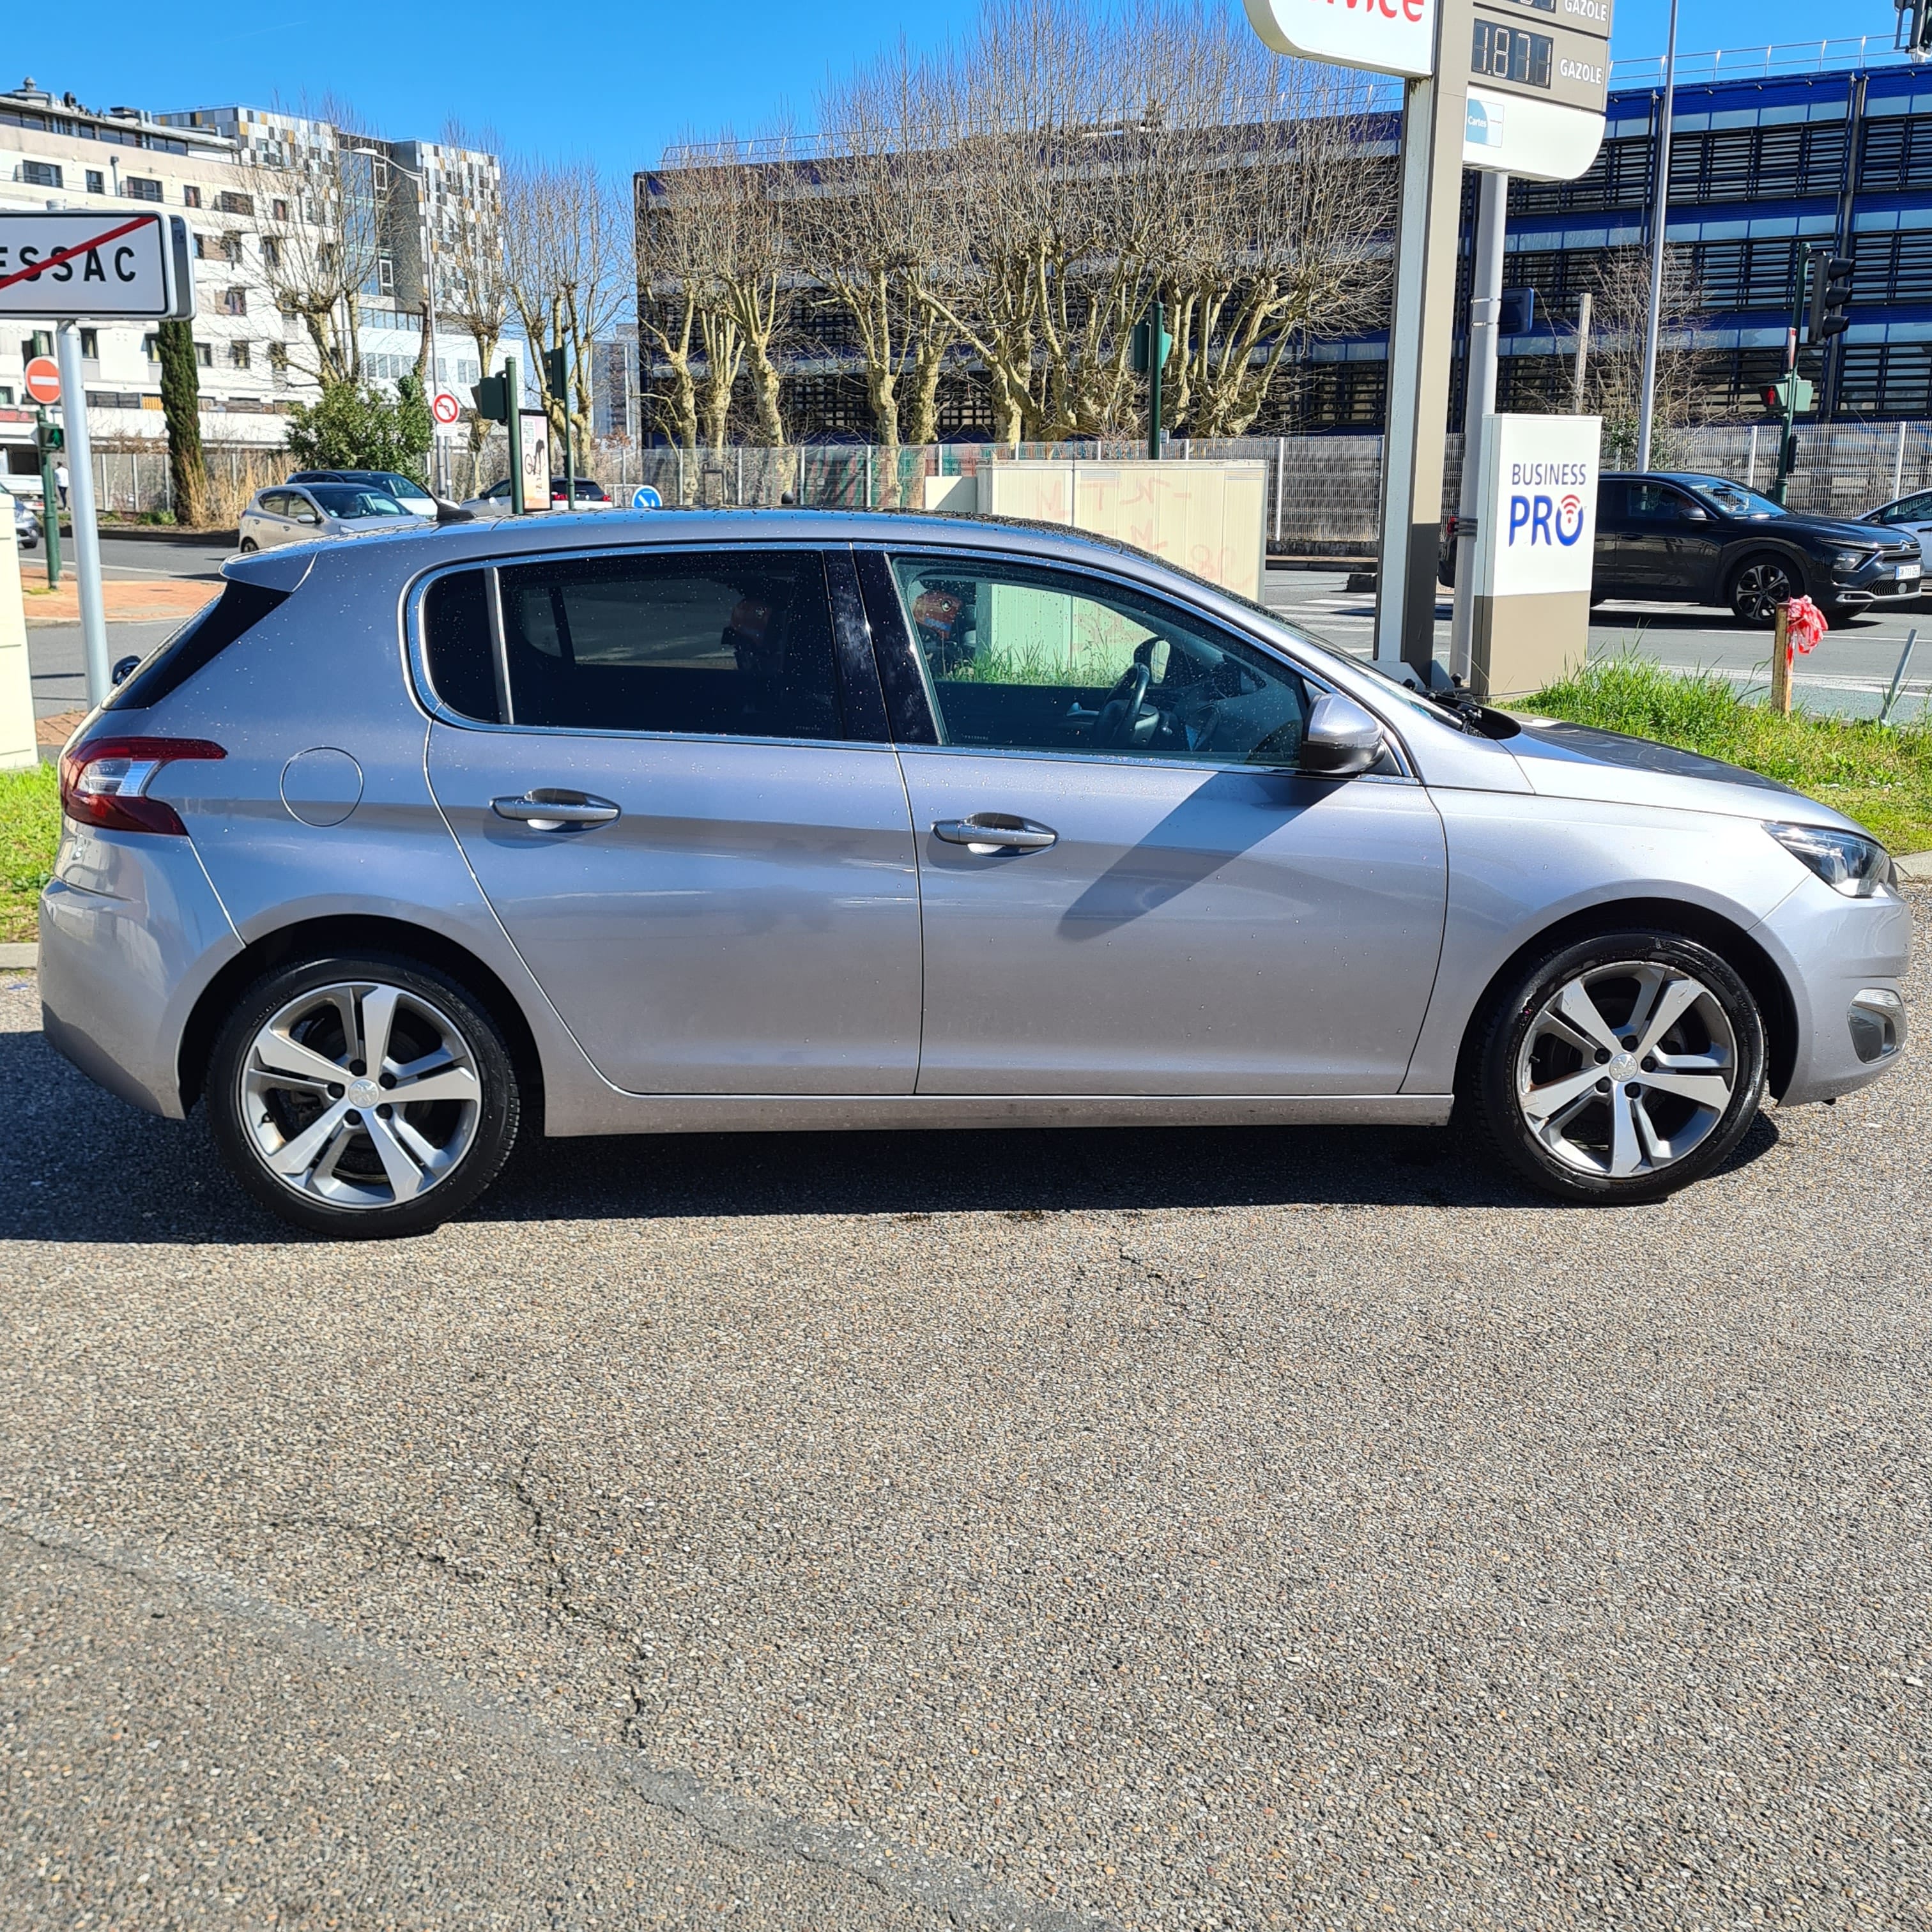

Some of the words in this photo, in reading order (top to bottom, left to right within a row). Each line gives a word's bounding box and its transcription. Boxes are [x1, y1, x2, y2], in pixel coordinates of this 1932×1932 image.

[1564, 0, 1607, 22] GAZOLE
[1560, 58, 1604, 85] GAZOLE
[1468, 115, 1487, 128] Cartes
[1512, 463, 1586, 486] BUSINESS
[1508, 494, 1584, 548] PRO
